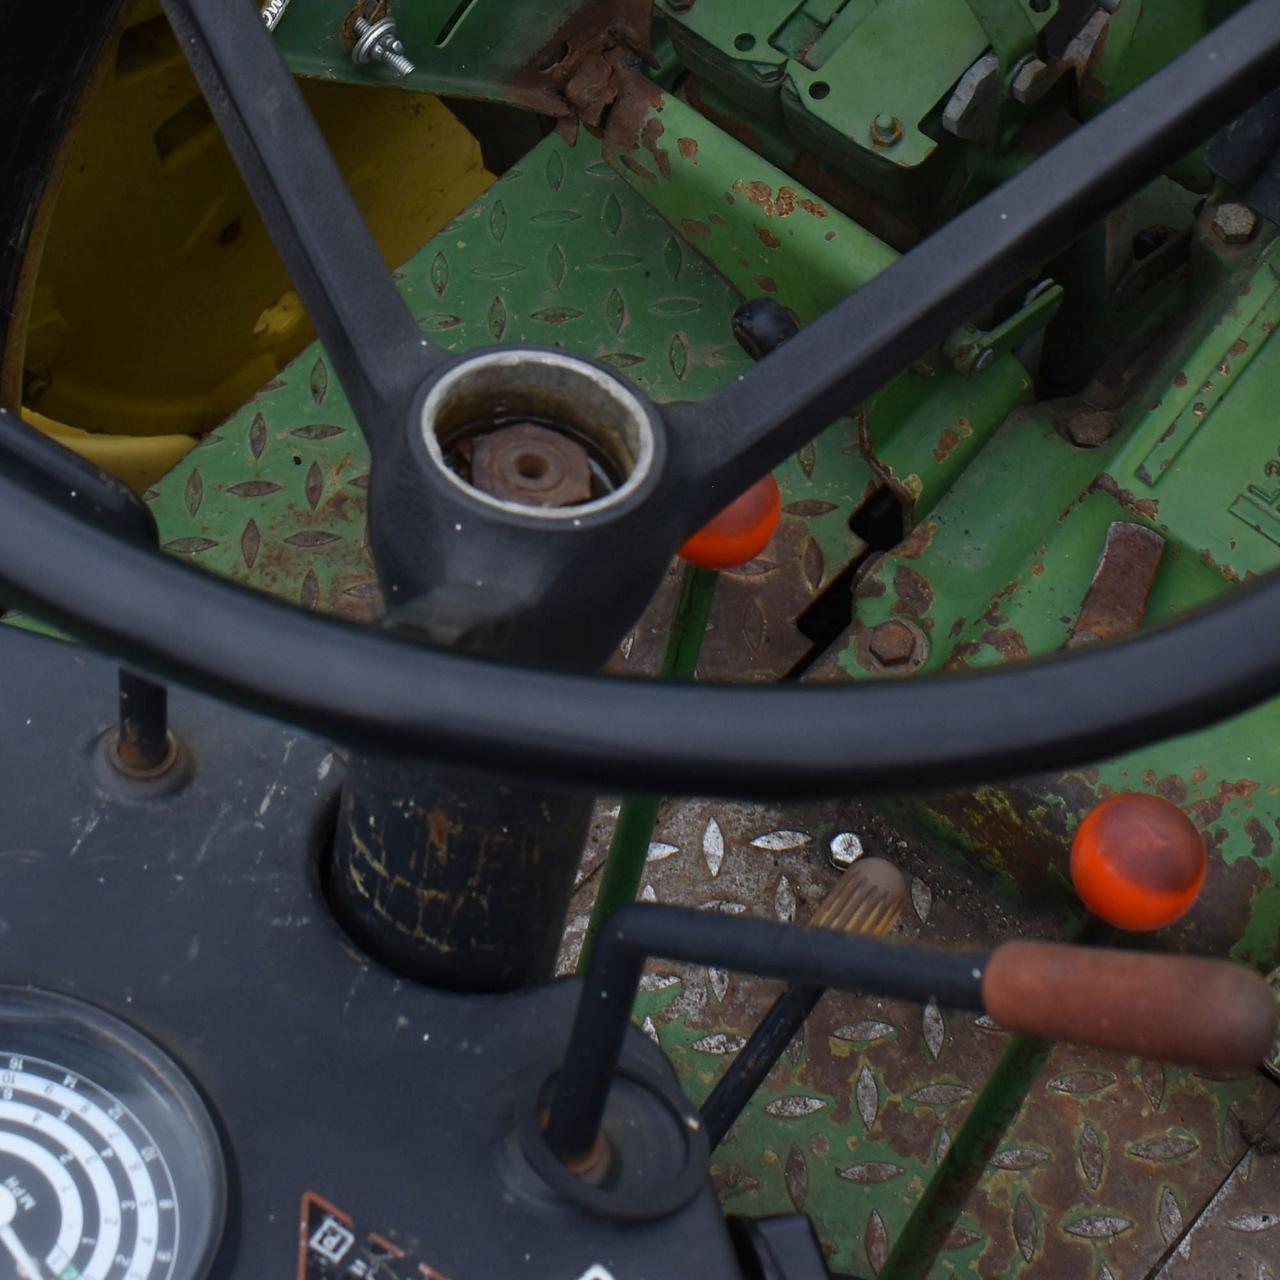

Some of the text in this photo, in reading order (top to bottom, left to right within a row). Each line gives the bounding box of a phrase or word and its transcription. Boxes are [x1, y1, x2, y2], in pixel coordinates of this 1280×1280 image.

[9, 1057, 23, 1070] 16
[2, 1071, 15, 1083] 10
[4, 1176, 36, 1211] MPH
